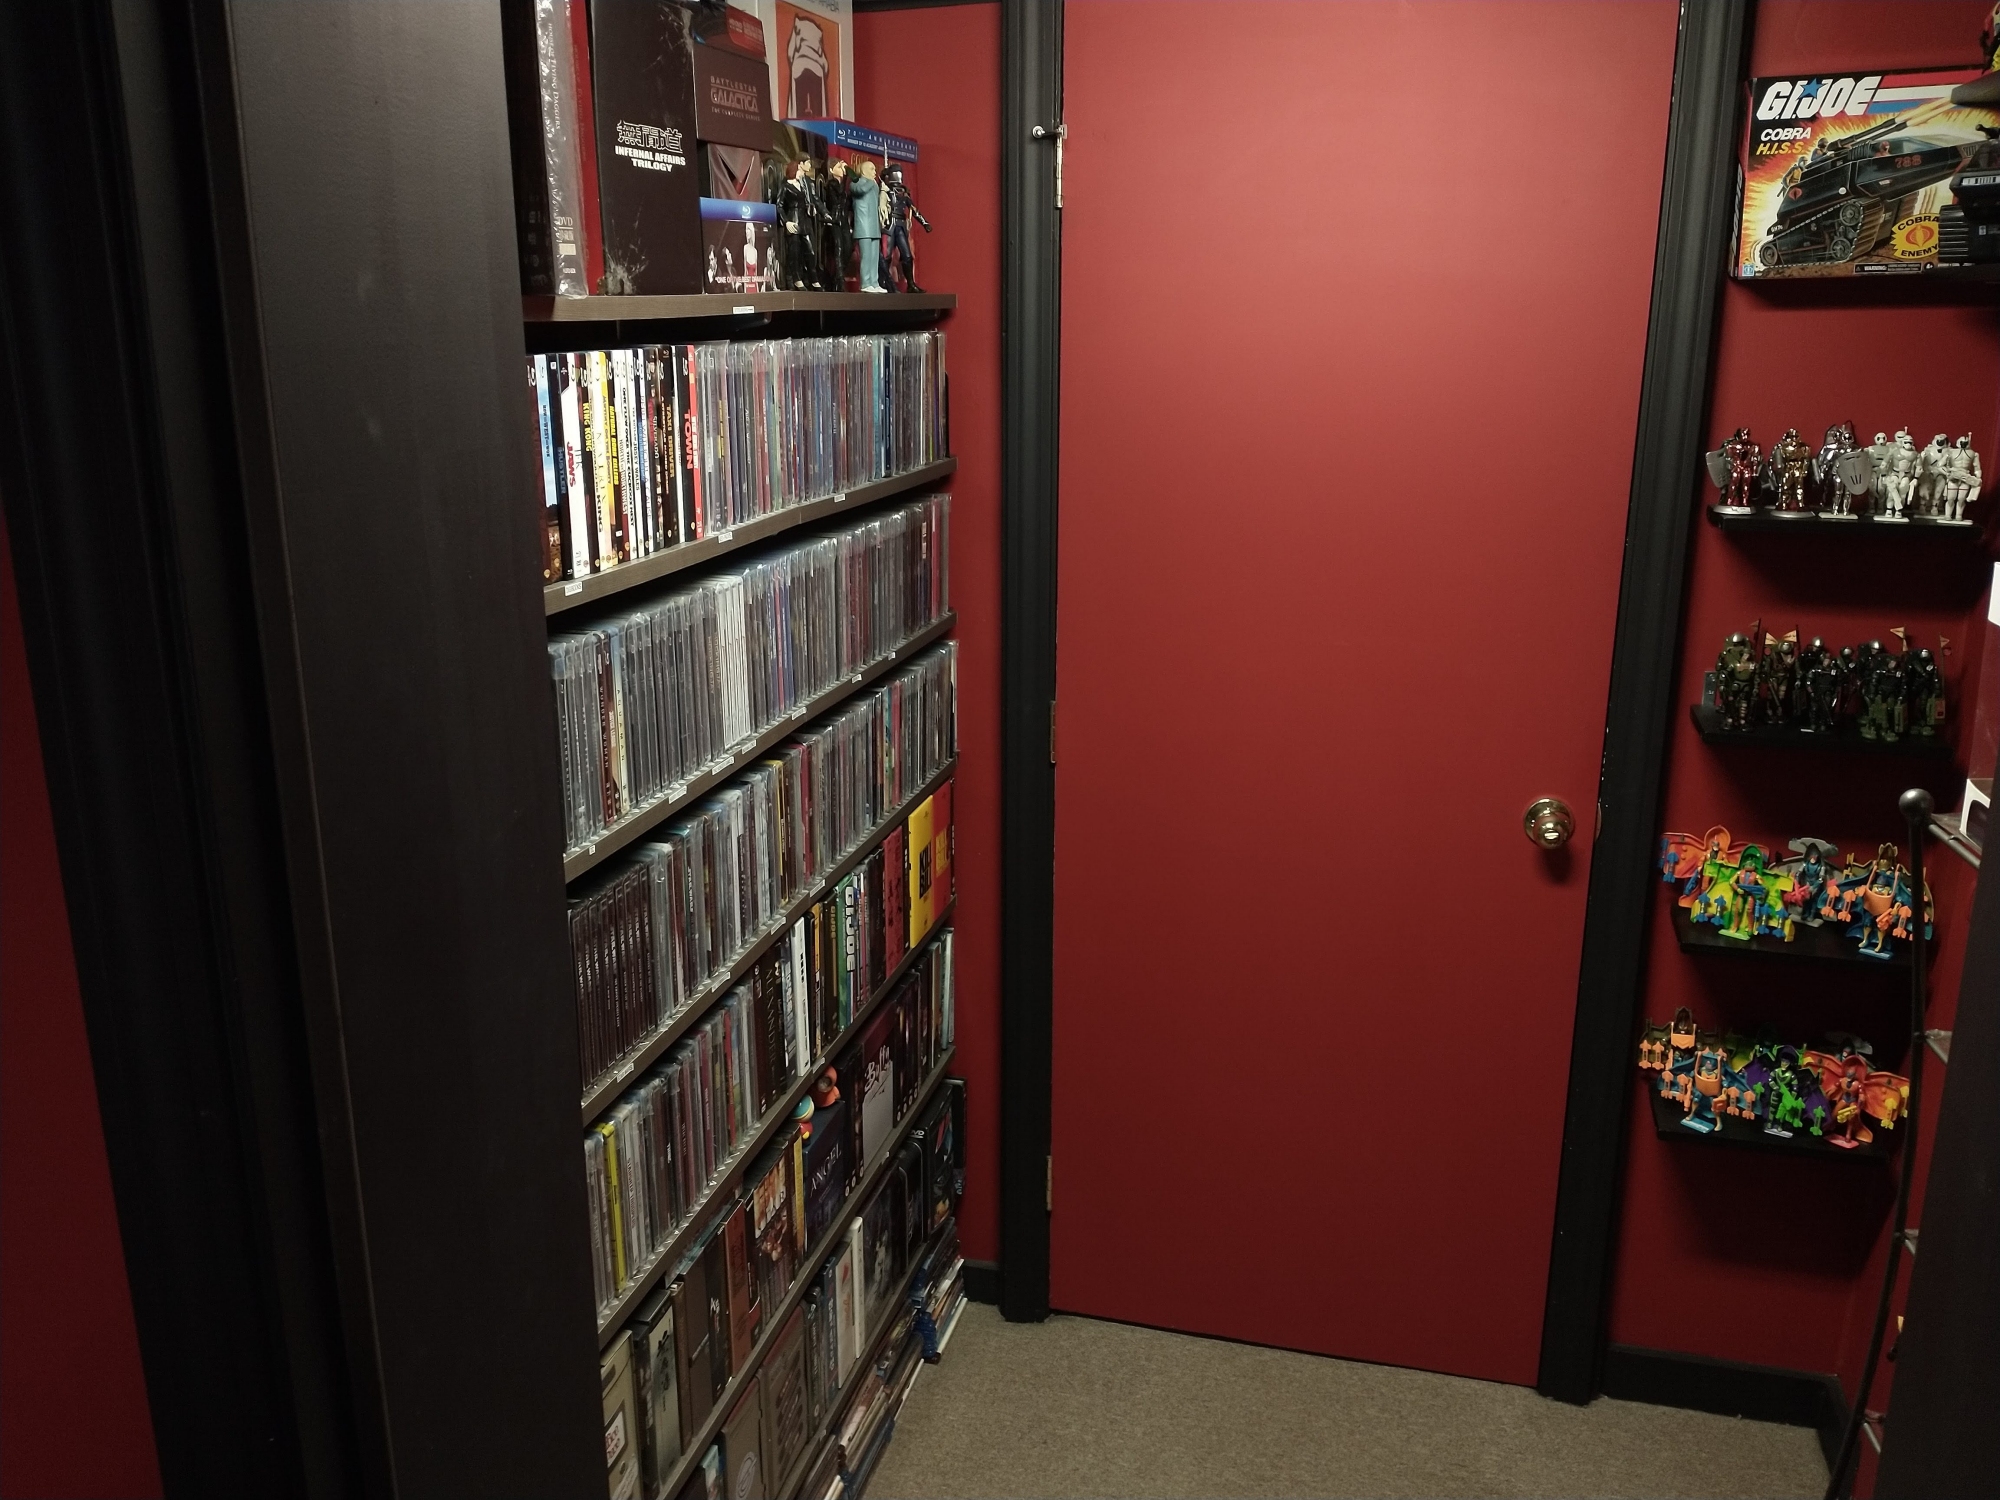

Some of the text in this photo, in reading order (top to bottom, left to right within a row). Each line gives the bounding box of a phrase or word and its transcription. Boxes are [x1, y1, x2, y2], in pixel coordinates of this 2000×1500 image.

[548, 59, 558, 88] FLYING
[710, 75, 757, 94] BATTLESTAR
[552, 91, 562, 130] DAGGERS
[710, 88, 758, 113] GALACTICA
[1755, 142, 1804, 157] H.I.S.S.
[1760, 126, 1812, 142] COBRA
[614, 146, 686, 166] INFERNAL AFFAIRS
[631, 157, 673, 173] TRILOGY
[1898, 216, 1940, 231] COBRA
[1901, 244, 1939, 257] ENEMY
[582, 403, 593, 451] KING KONG
[652, 416, 660, 459] SILVERADO
[684, 409, 693, 469] TOWN
[557, 448, 566, 494] HUSTLER
[566, 442, 576, 487] JAWS
[667, 436, 675, 478] DRIVER
[619, 471, 628, 515] NORTHWEST
[596, 495, 604, 532] KING
[616, 690, 626, 761] AQUAMAN
[920, 843, 932, 870] KILL
[764, 968, 776, 1063] ALEXANDER
[864, 1044, 892, 1092] Buffy
[626, 1158, 634, 1193] STARSHIP
[810, 1143, 842, 1198] ANGEL
